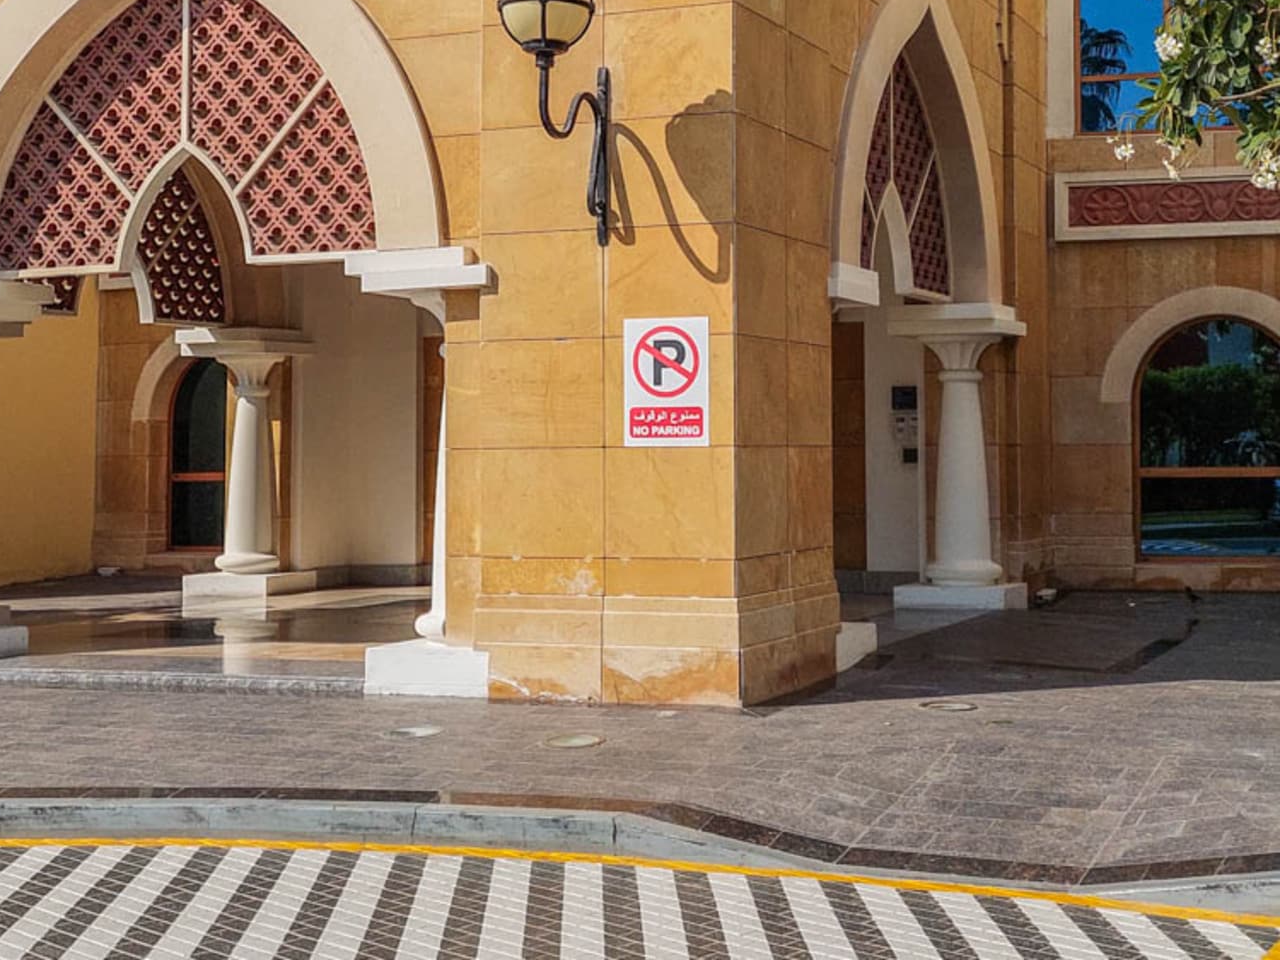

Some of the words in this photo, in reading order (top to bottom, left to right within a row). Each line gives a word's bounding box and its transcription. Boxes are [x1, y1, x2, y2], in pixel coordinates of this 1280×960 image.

[634, 410, 667, 423] الوقوف
[670, 411, 700, 424] ممنوع
[633, 426, 649, 436] NO
[651, 425, 700, 436] PARKING
